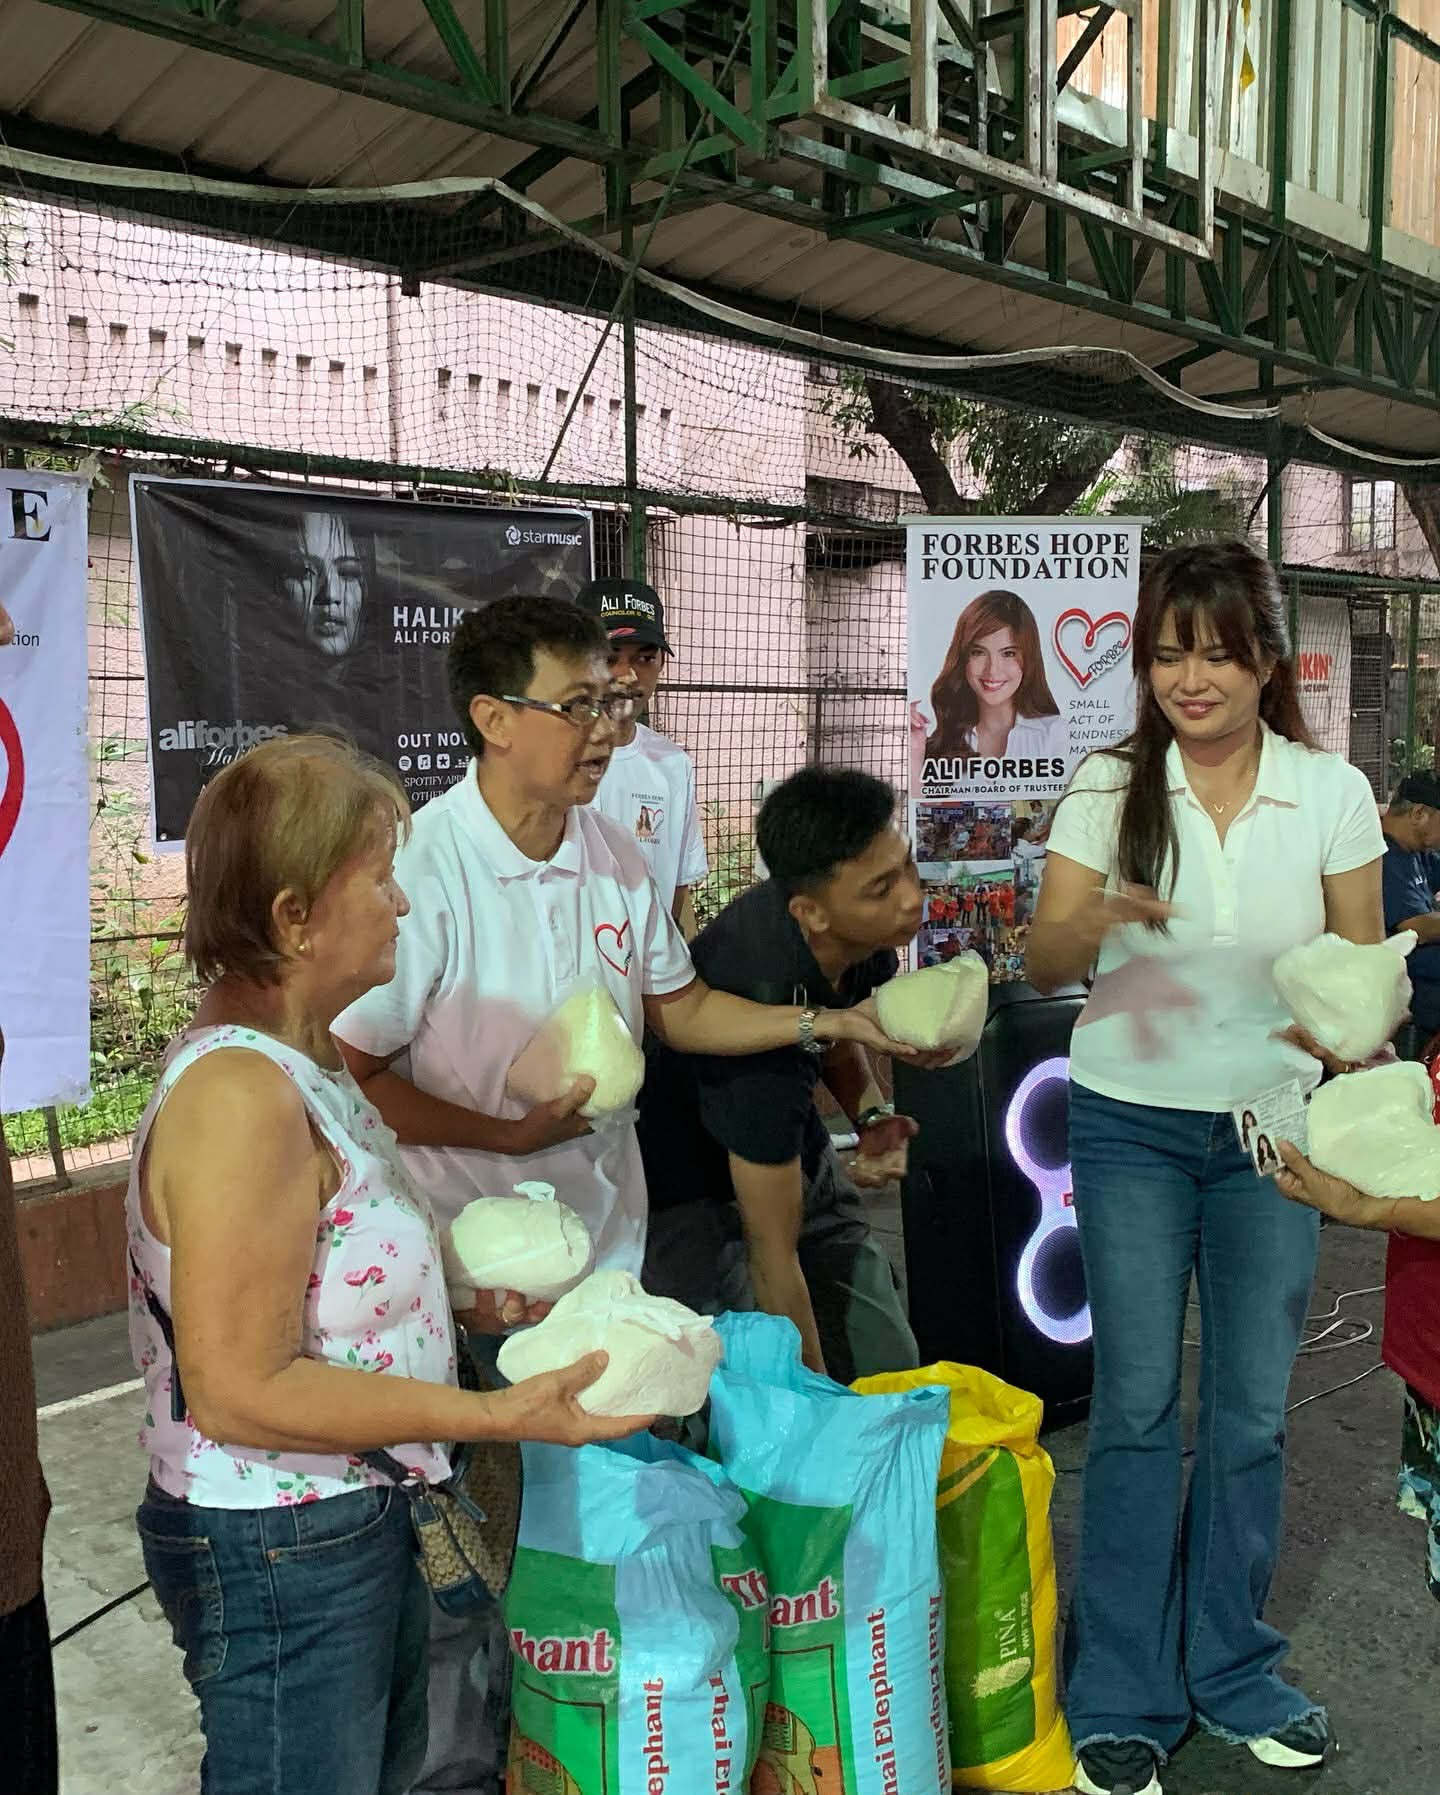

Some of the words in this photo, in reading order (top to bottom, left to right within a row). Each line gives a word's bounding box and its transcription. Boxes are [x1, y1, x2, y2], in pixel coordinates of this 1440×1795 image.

[6, 488, 51, 541] E
[523, 529, 582, 546] starmusic
[921, 533, 1040, 556] FORBES
[1050, 533, 1129, 555] HOPE
[921, 556, 1129, 580] FOUNDATION
[394, 631, 418, 643] ALI
[422, 631, 456, 643] FOR
[1296, 653, 1332, 680] KIN'
[1069, 701, 1110, 710] SMALL
[1069, 715, 1095, 725] ACT
[1098, 715, 1114, 724] OF
[398, 733, 432, 748] OUT
[922, 760, 960, 780] ALI
[969, 758, 1065, 779] FORBES
[404, 776, 443, 787] SPOTIFY
[446, 775, 465, 785] APP
[1008, 784, 1021, 793] OF
[770, 1581, 838, 1626] ant
[867, 1608, 894, 1748] Elephant
[709, 1670, 732, 1750] Thai
[643, 1677, 669, 1795] ephant
[716, 1759, 731, 1795] El
